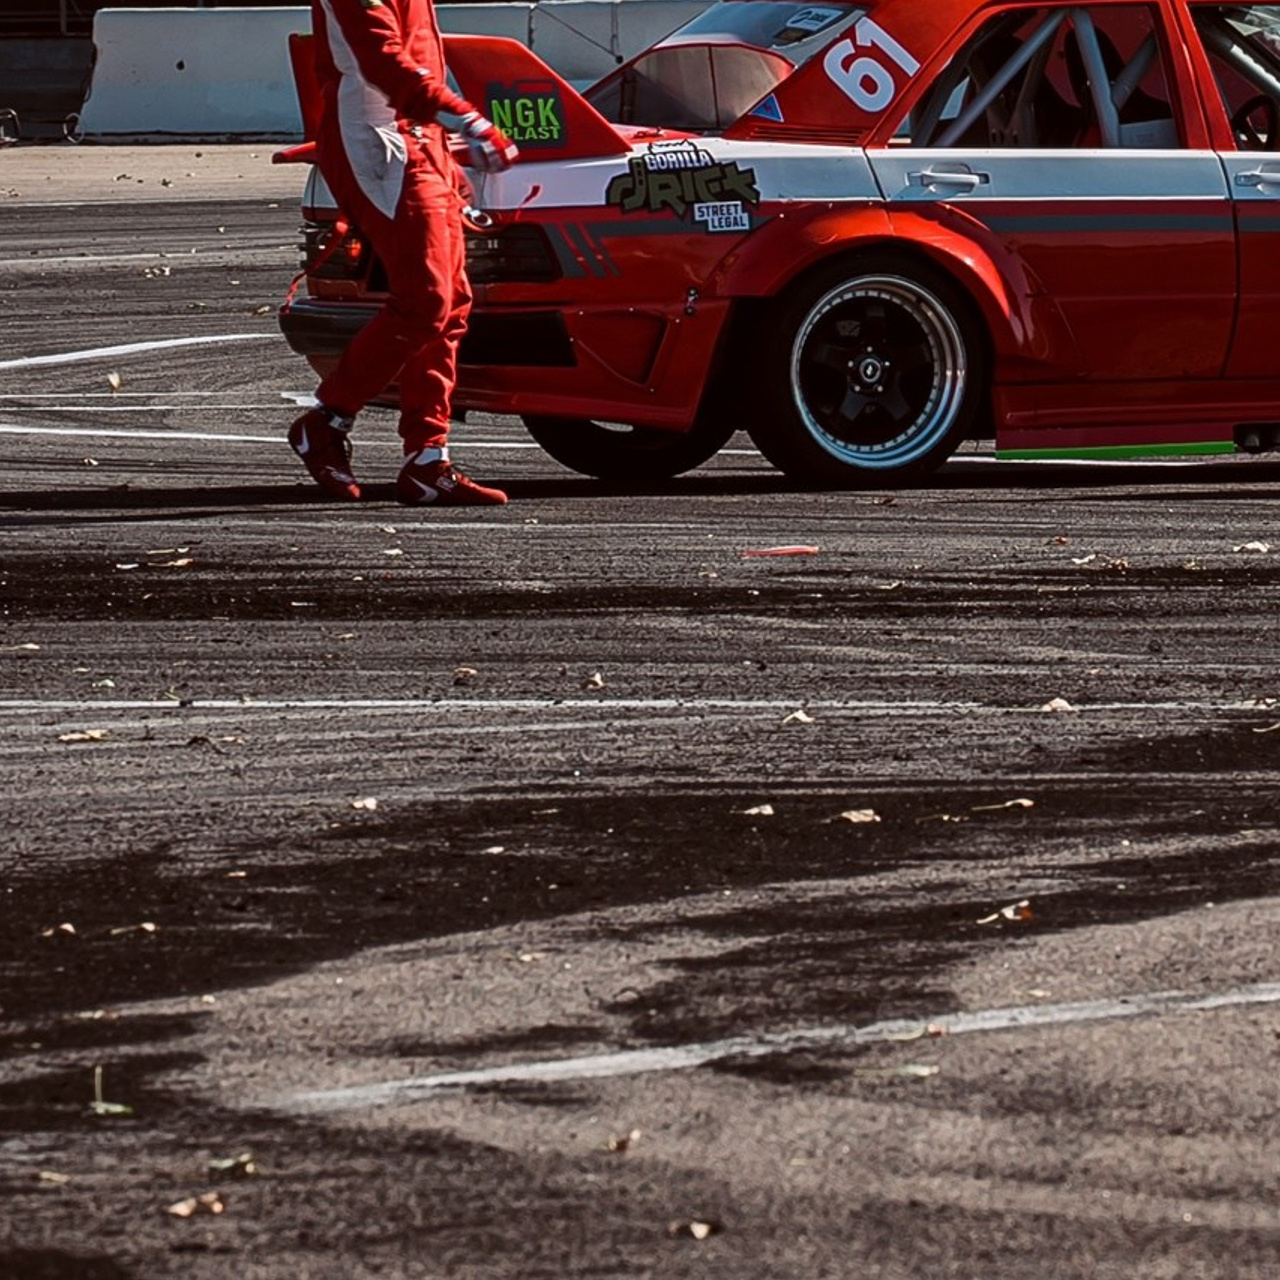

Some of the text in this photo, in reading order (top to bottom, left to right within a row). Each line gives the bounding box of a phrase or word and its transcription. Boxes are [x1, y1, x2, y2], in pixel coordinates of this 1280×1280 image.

[823, 17, 921, 113] 61
[491, 98, 560, 128] NGK
[645, 151, 712, 170] GORILLA
[697, 204, 740, 218] STREET
[711, 215, 747, 229] LEGAL
